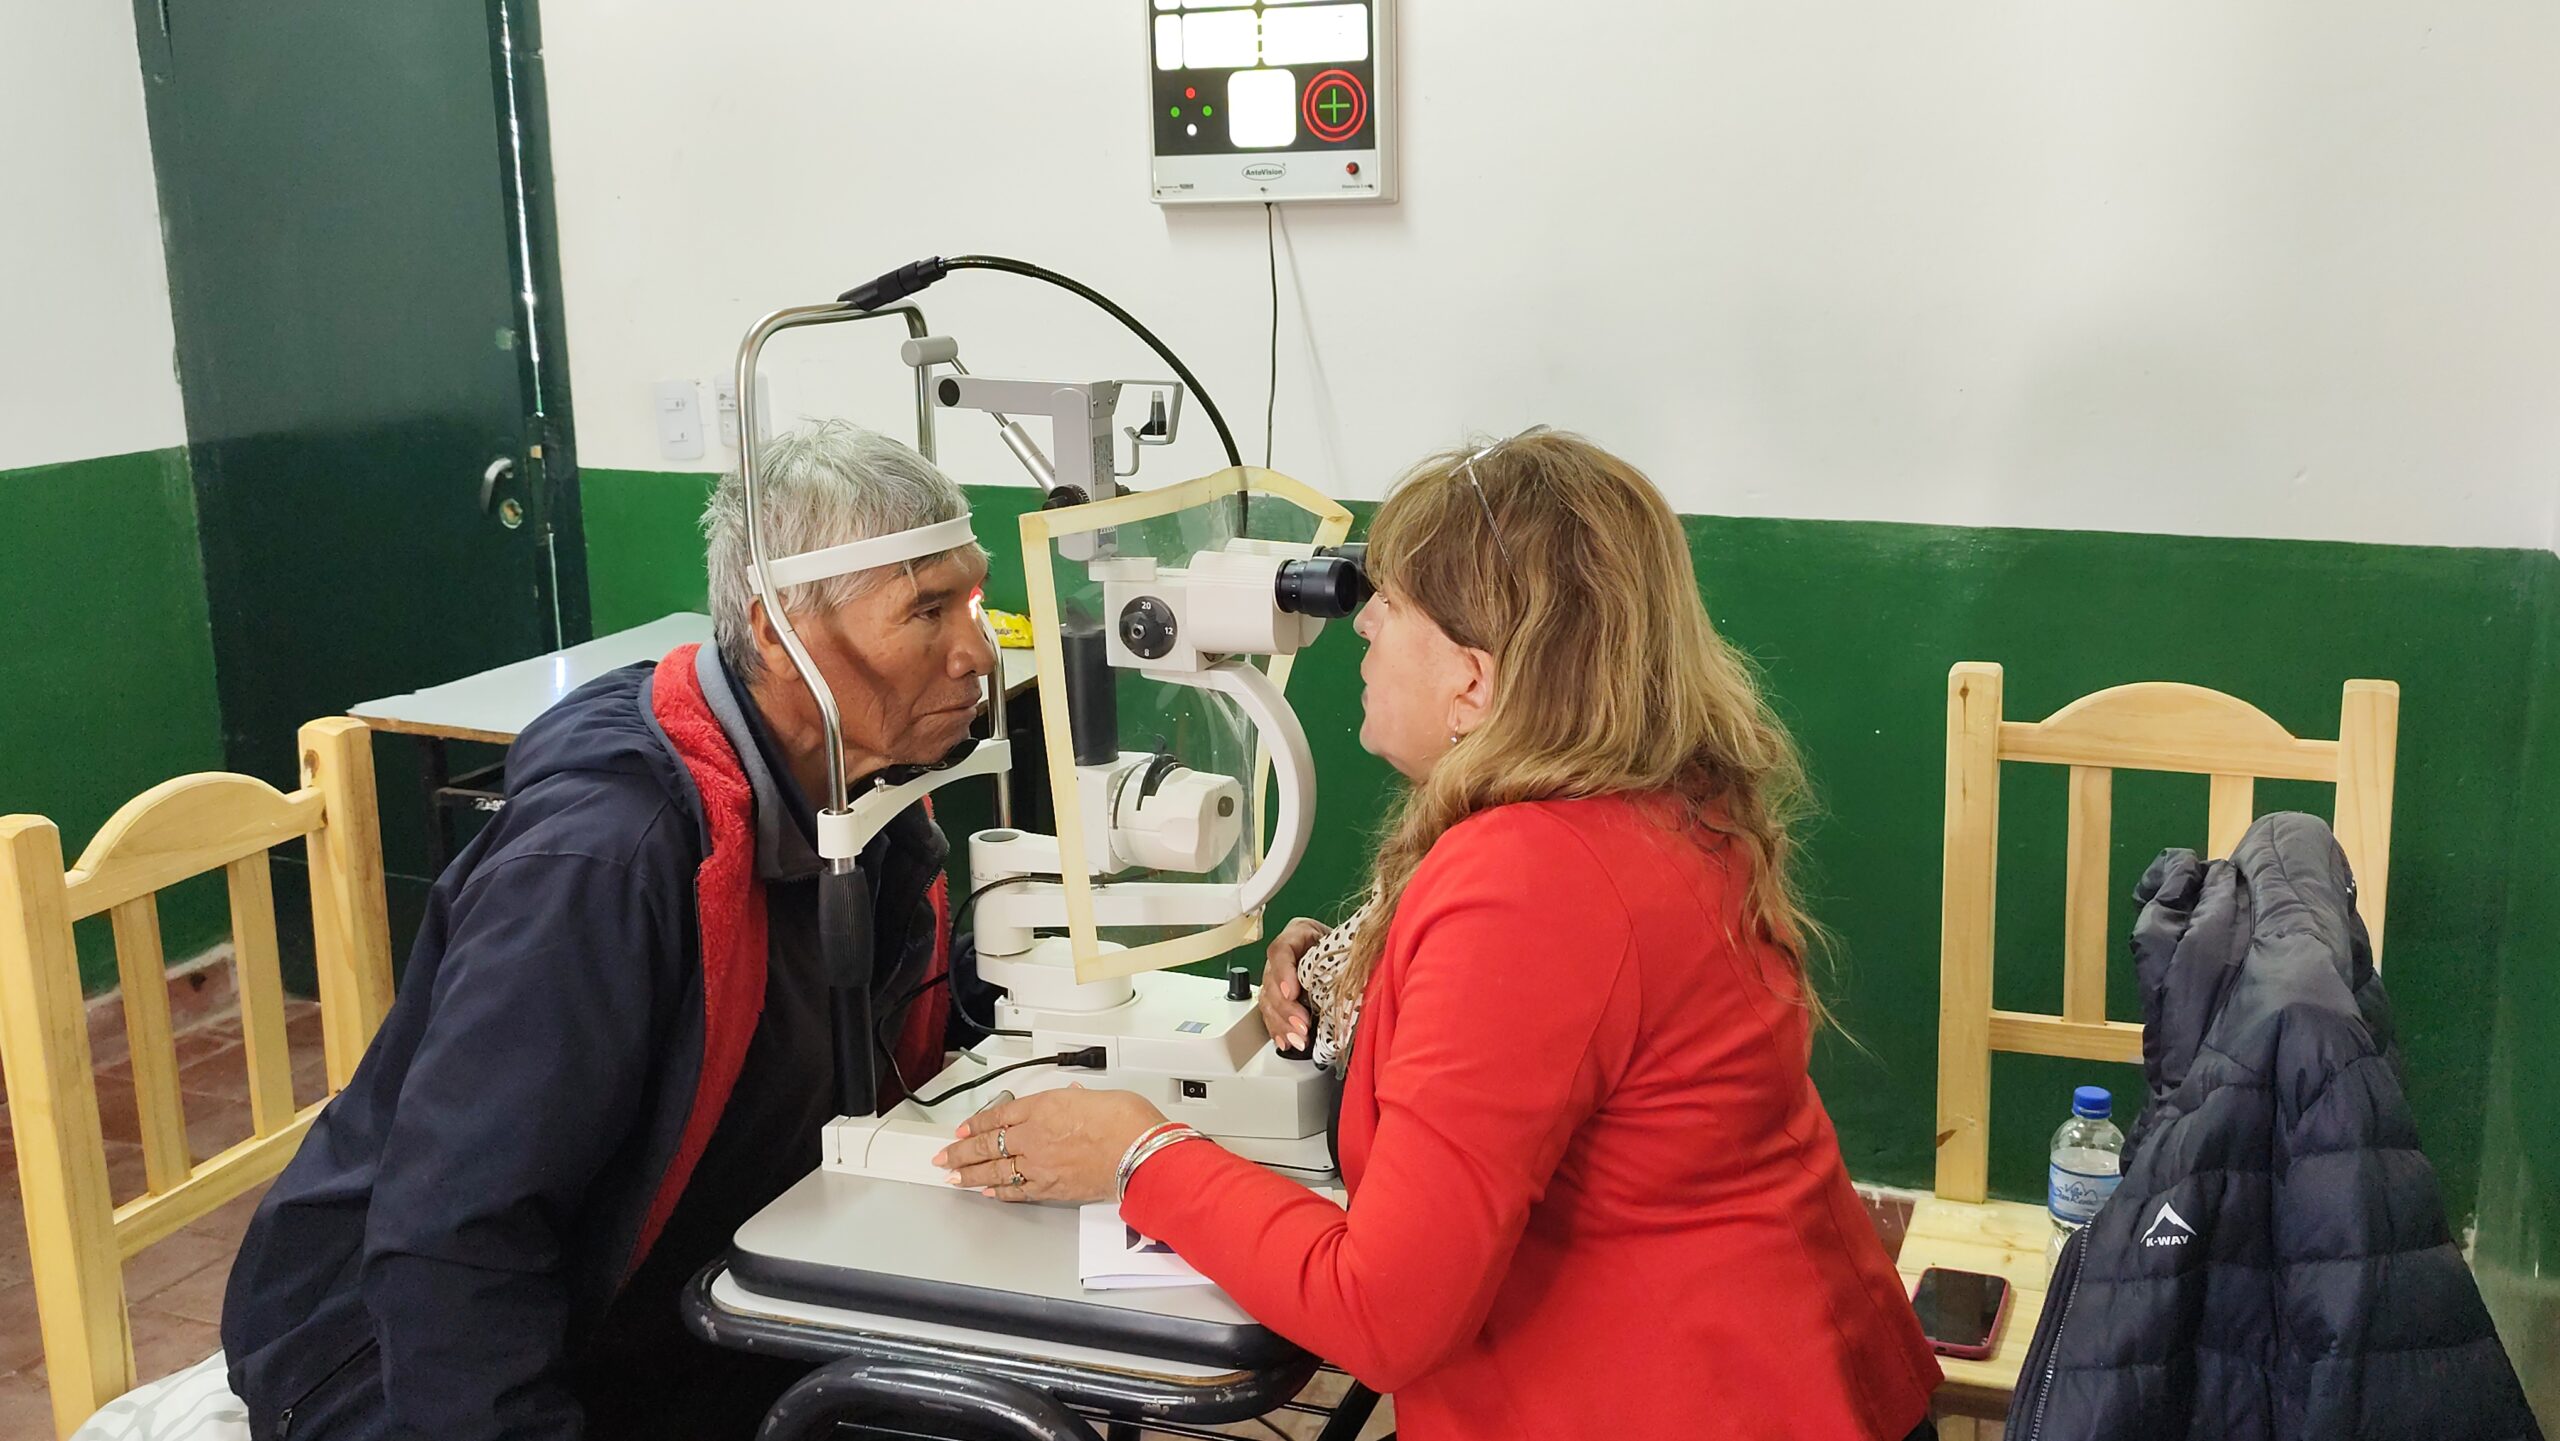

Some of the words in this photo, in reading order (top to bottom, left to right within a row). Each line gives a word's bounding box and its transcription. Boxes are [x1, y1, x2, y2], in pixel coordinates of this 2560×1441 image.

[1141, 601, 1152, 610] 20
[1164, 626, 1174, 635] 12
[1144, 648, 1150, 657] 8
[2146, 1234, 2189, 1248] K-WAY
